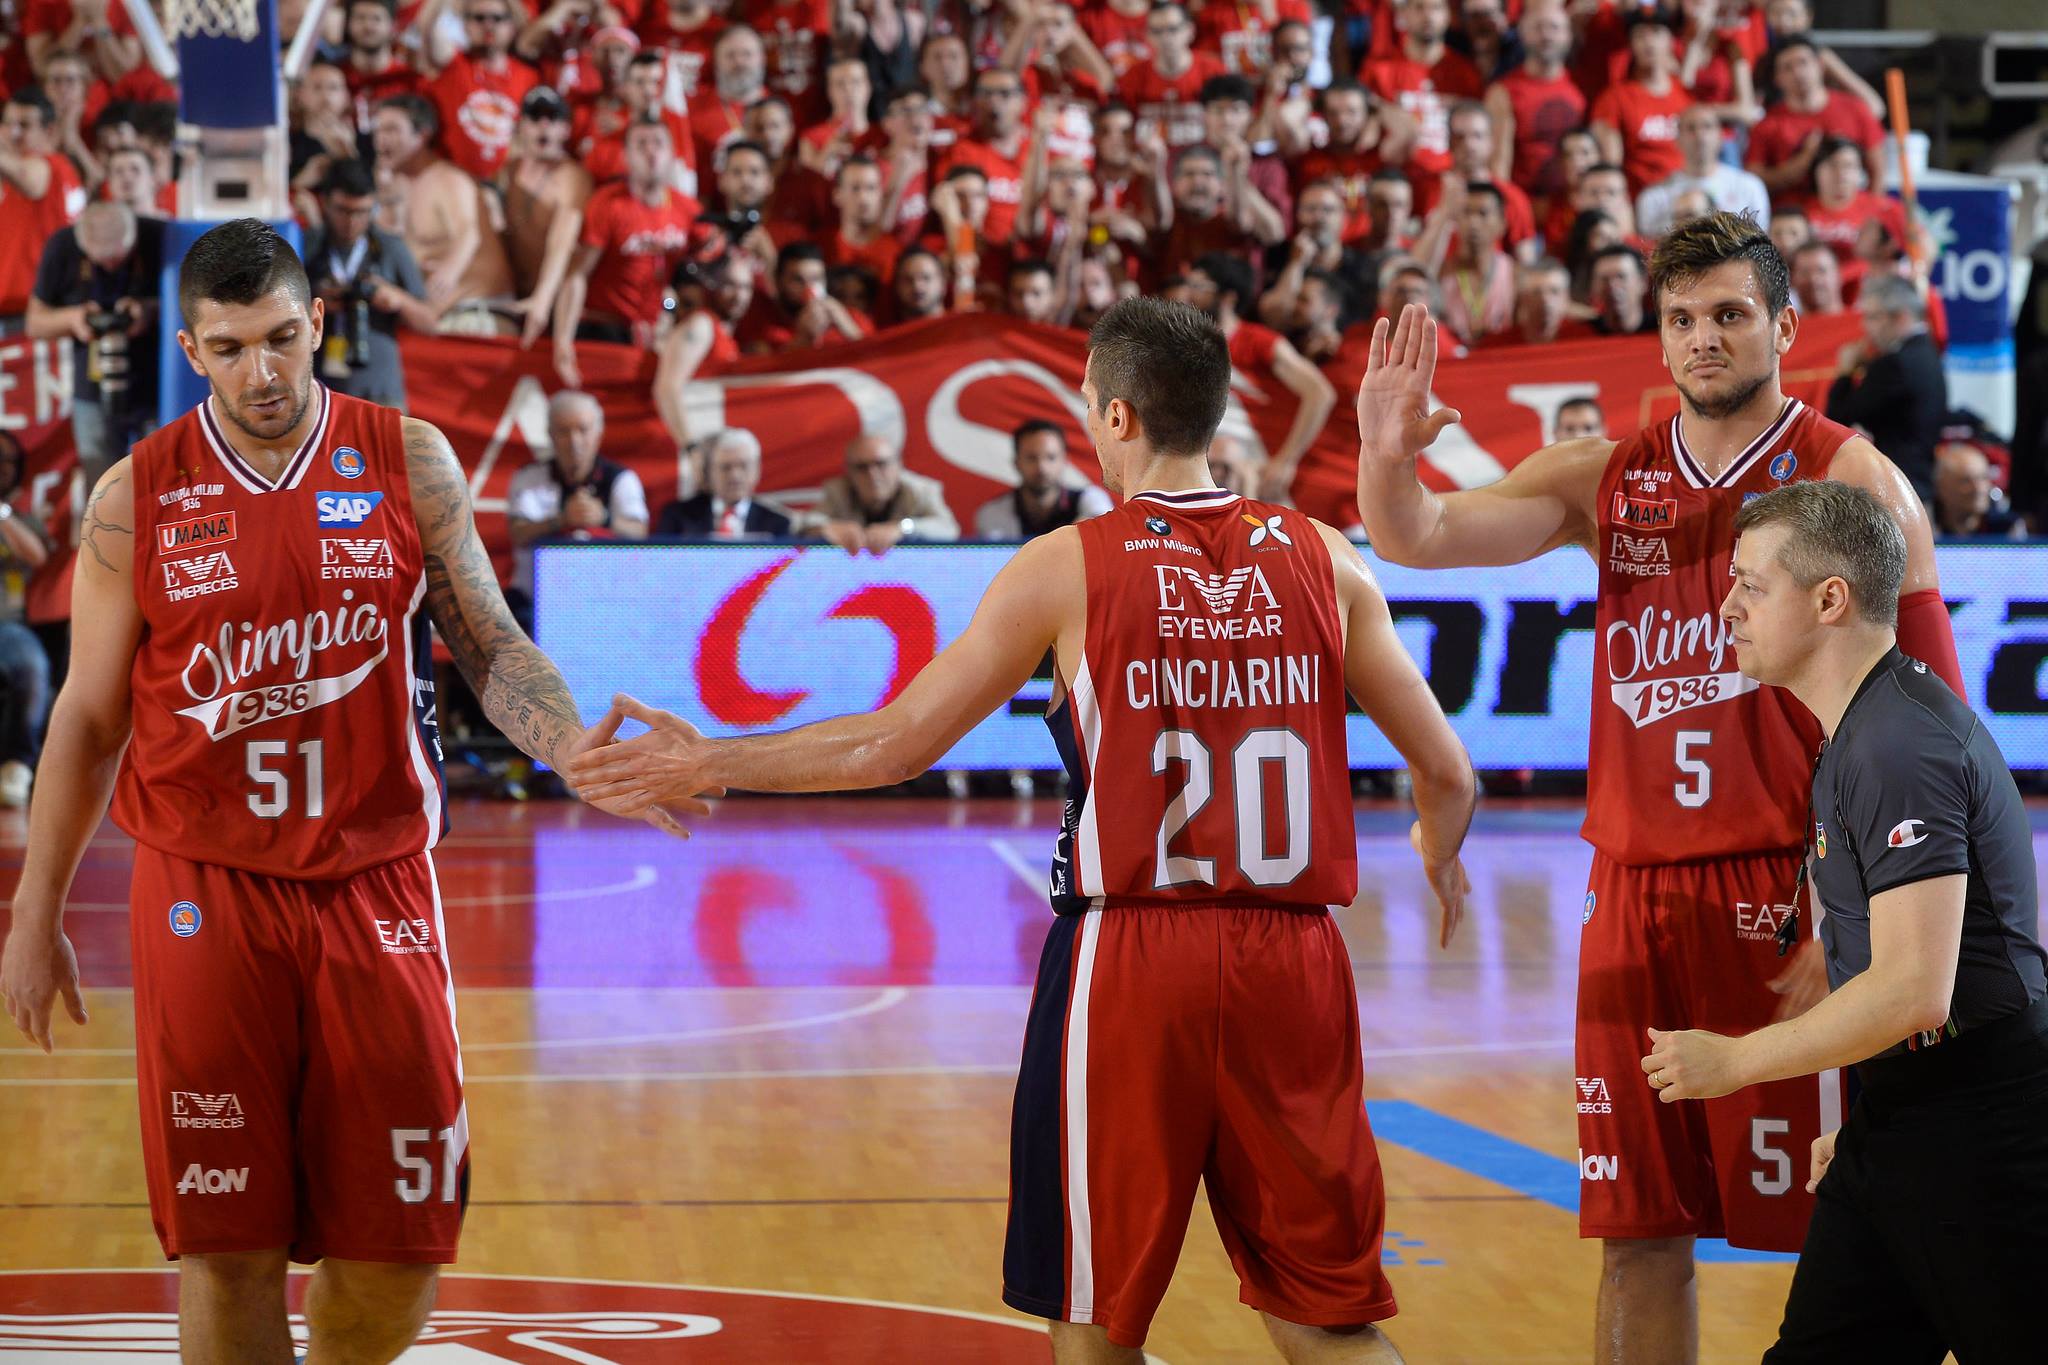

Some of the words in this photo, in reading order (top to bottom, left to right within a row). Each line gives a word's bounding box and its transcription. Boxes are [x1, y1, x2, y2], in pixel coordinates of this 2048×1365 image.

[318, 497, 371, 522] SAP
[1638, 481, 1657, 492] 1936
[162, 518, 229, 548] UMANA
[1124, 539, 1160, 552] BMW
[1163, 539, 1202, 556] Milano
[166, 577, 239, 602] TIMEPIECES
[321, 567, 394, 579] EYEWEAR
[181, 589, 388, 701] Olimpia
[1158, 614, 1283, 640] EYEWEAR
[1126, 655, 1319, 710] CINCIARINI
[1634, 676, 1720, 723] 1936
[212, 683, 310, 737] 1936
[246, 739, 324, 818] 51
[1674, 729, 1712, 809] 5
[1151, 727, 1313, 888] 20
[172, 1116, 245, 1129] TIMEPIECES
[391, 1127, 457, 1202] 51
[1750, 1117, 1792, 1196] 5
